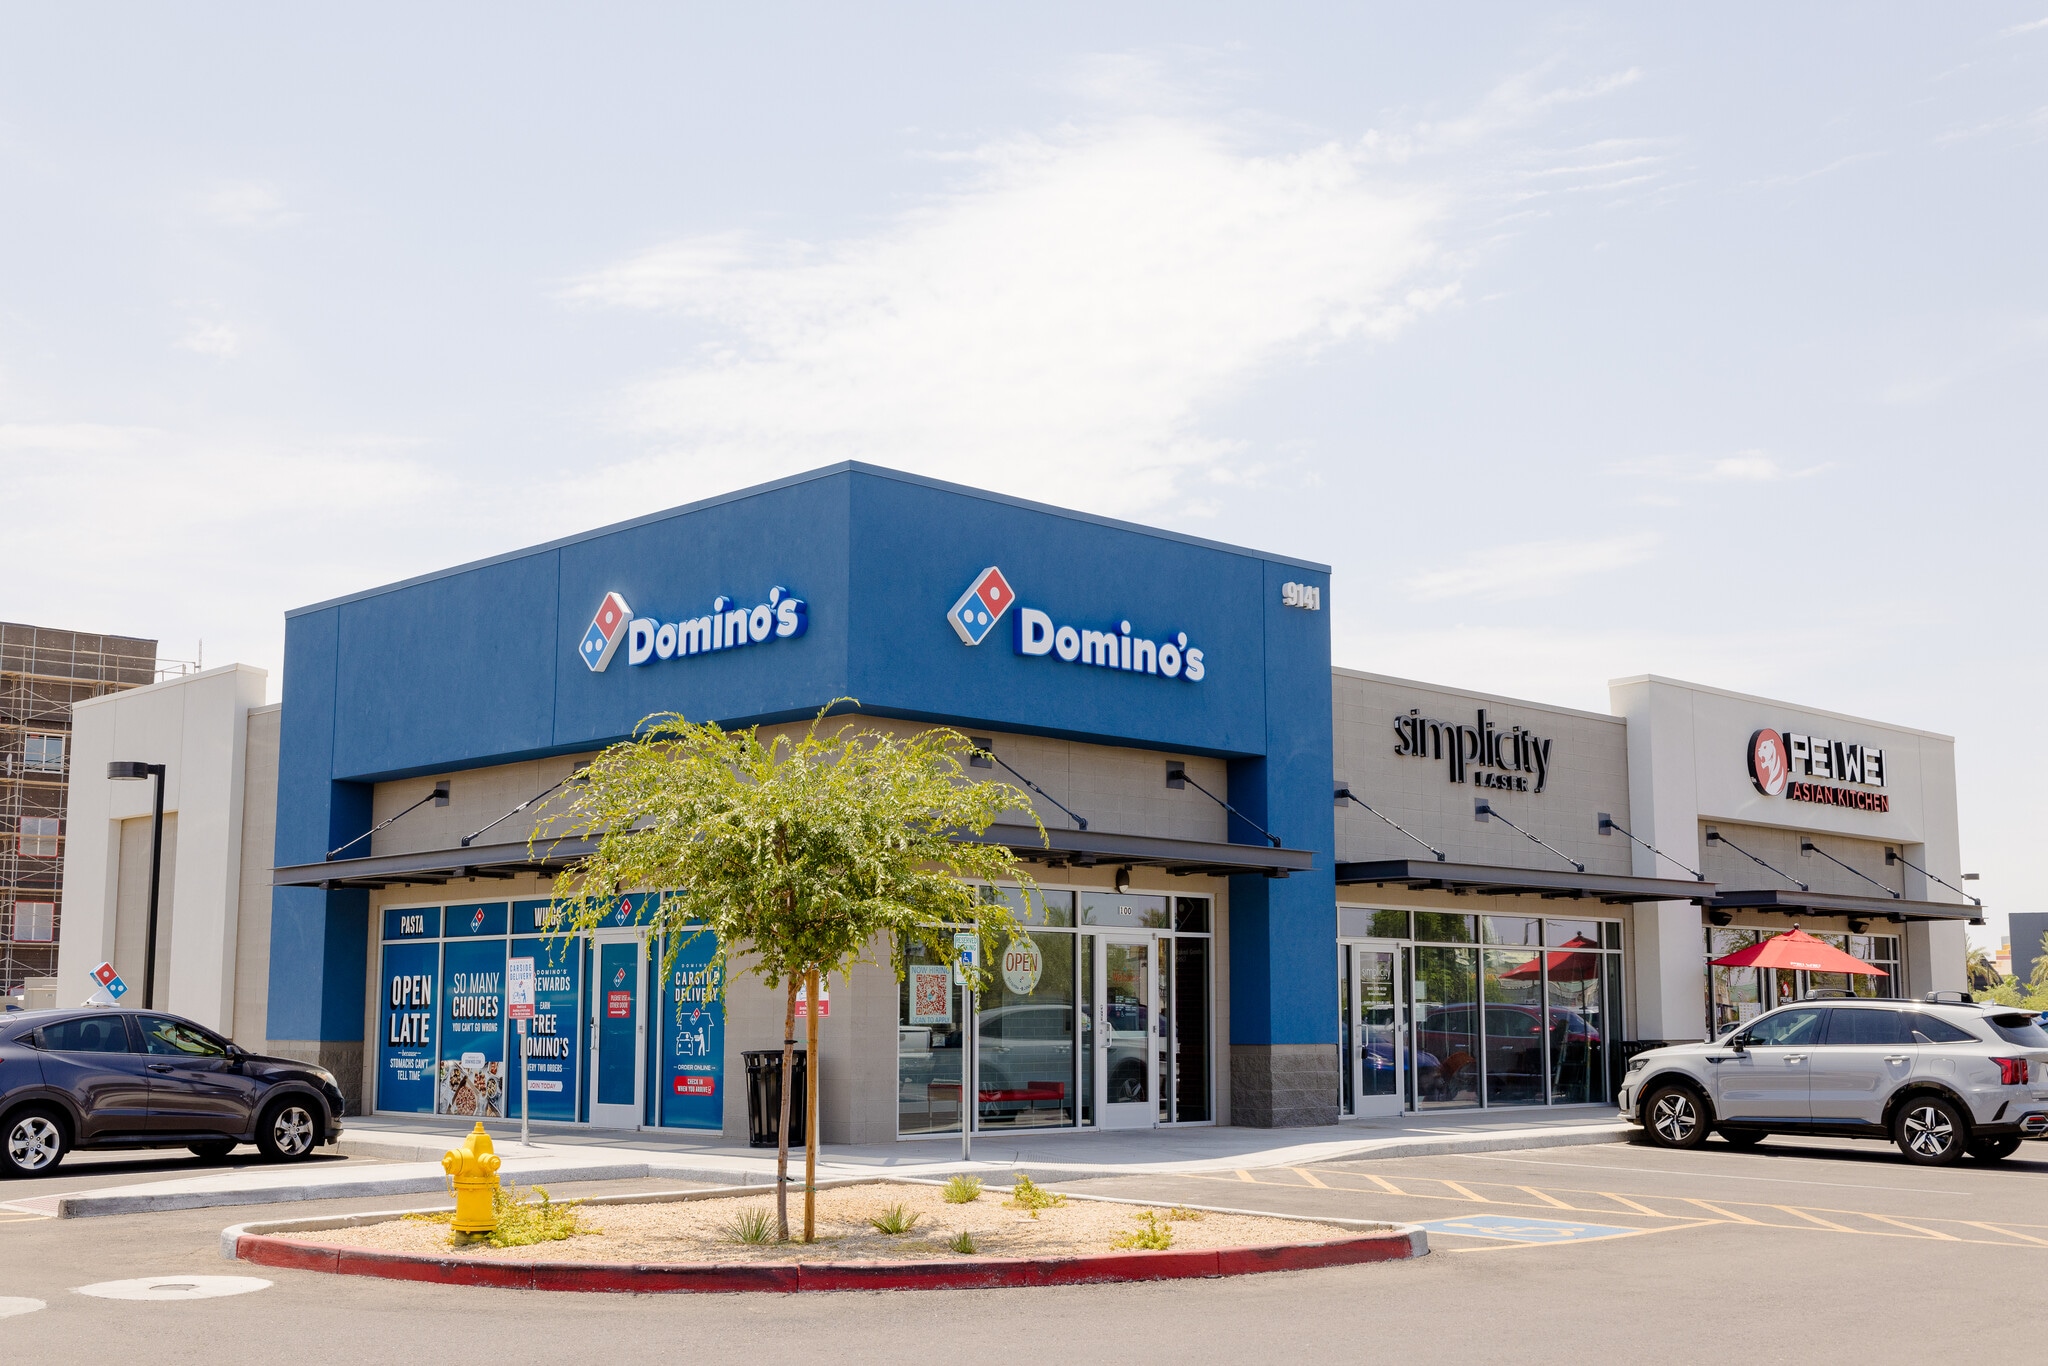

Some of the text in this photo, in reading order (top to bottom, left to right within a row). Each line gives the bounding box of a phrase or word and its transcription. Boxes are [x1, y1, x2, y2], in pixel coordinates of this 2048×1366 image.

[1282, 581, 1321, 611] 9141
[628, 585, 806, 667] Domino's
[1015, 607, 1206, 682] Domino's
[1394, 708, 1553, 793] simplicity
[1475, 771, 1529, 792] LASER
[1787, 781, 1890, 812] ASIAN KITCHEN
[1119, 906, 1132, 915] 100
[401, 915, 424, 934] PASTA
[510, 964, 532, 972] CARSIDE
[911, 966, 928, 974] NOW
[929, 966, 951, 975] HIRING
[1006, 952, 1038, 972] OPEN
[454, 972, 500, 994] SO MANY
[510, 972, 532, 981] DELIVERY
[534, 976, 571, 992] REWARDS
[392, 975, 432, 1006] OPEN
[452, 995, 499, 1018] CHOICES
[539, 1001, 551, 1010] EARN
[390, 1012, 431, 1044] LATE
[452, 1022, 498, 1032] YOU CAN'T GO WRONG
[532, 1014, 557, 1034] FREE
[389, 1058, 429, 1069] STOMACHS CAN'T
[537, 1064, 547, 1072] TWO
[547, 1064, 563, 1073] ORDERS
[397, 1070, 421, 1081] TELL TIME
